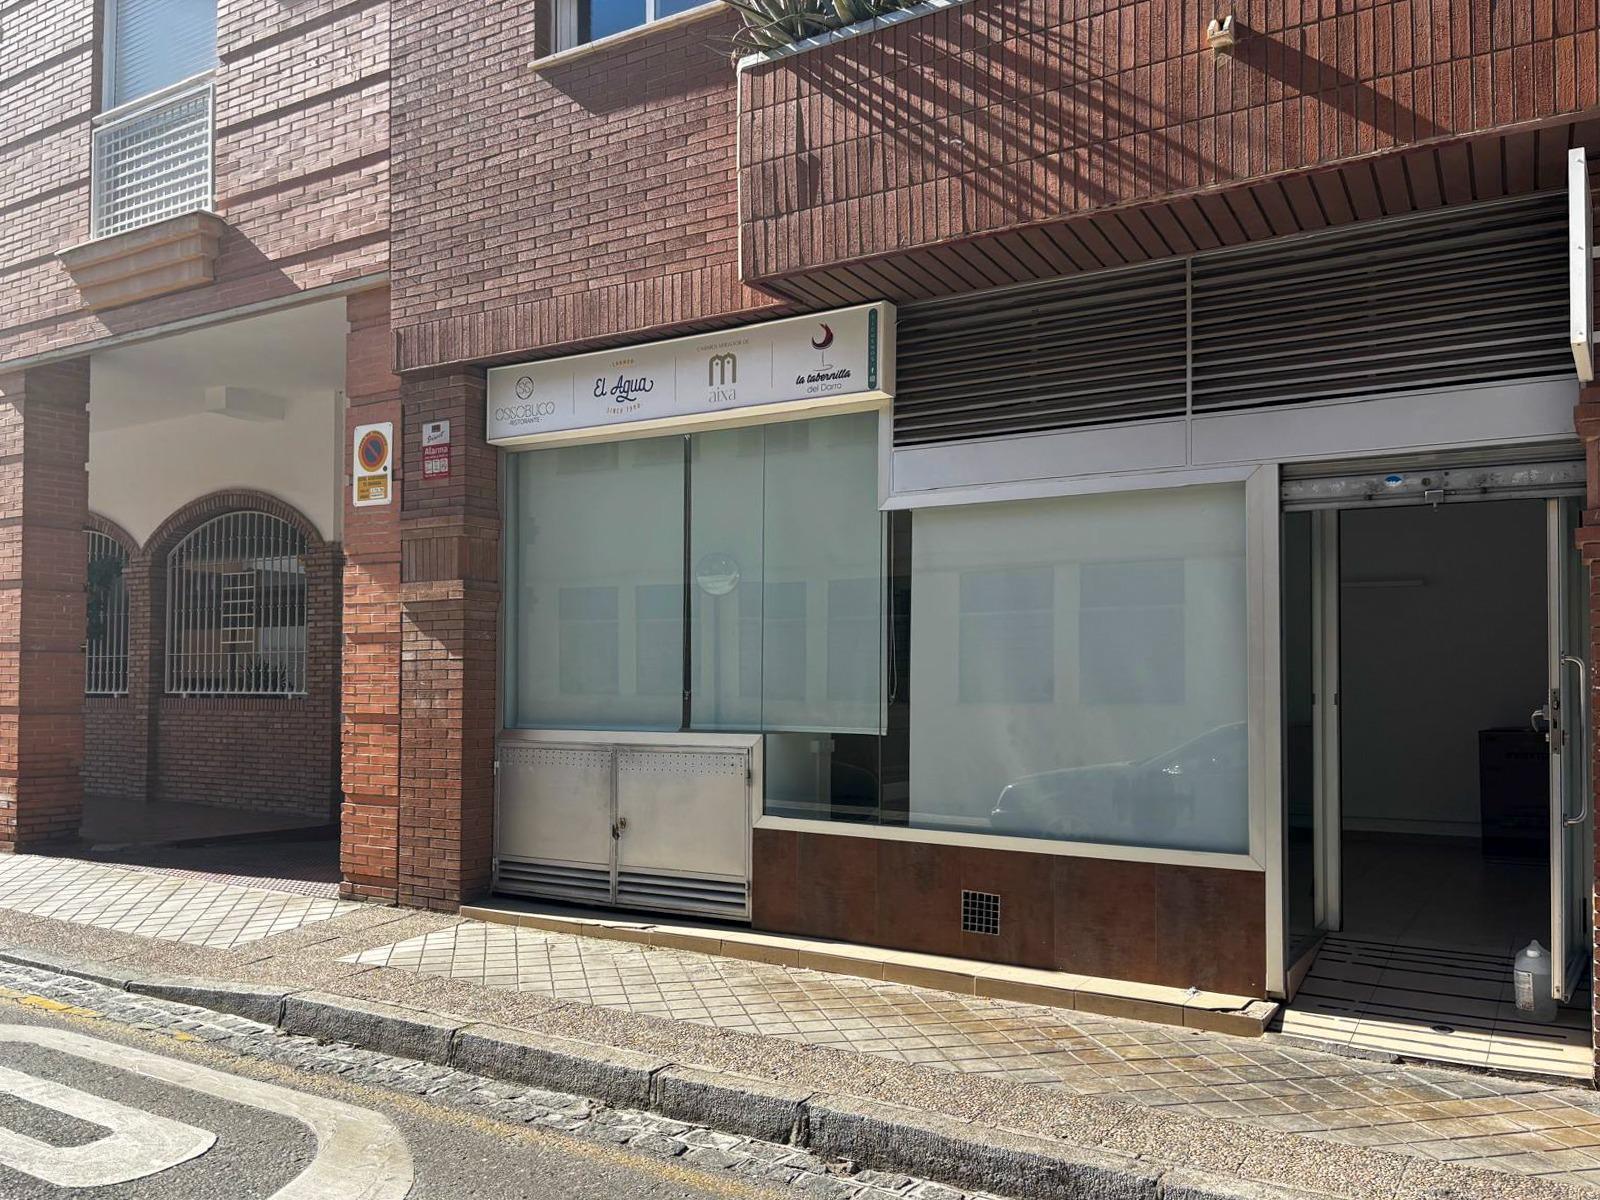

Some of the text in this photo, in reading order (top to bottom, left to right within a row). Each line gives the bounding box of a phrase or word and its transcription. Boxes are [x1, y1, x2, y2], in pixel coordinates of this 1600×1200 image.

[796, 368, 852, 385] la tabernilla
[593, 374, 654, 403] El Agua
[708, 387, 737, 402] aixa
[807, 384, 819, 393] del
[424, 446, 449, 455] Alarma
